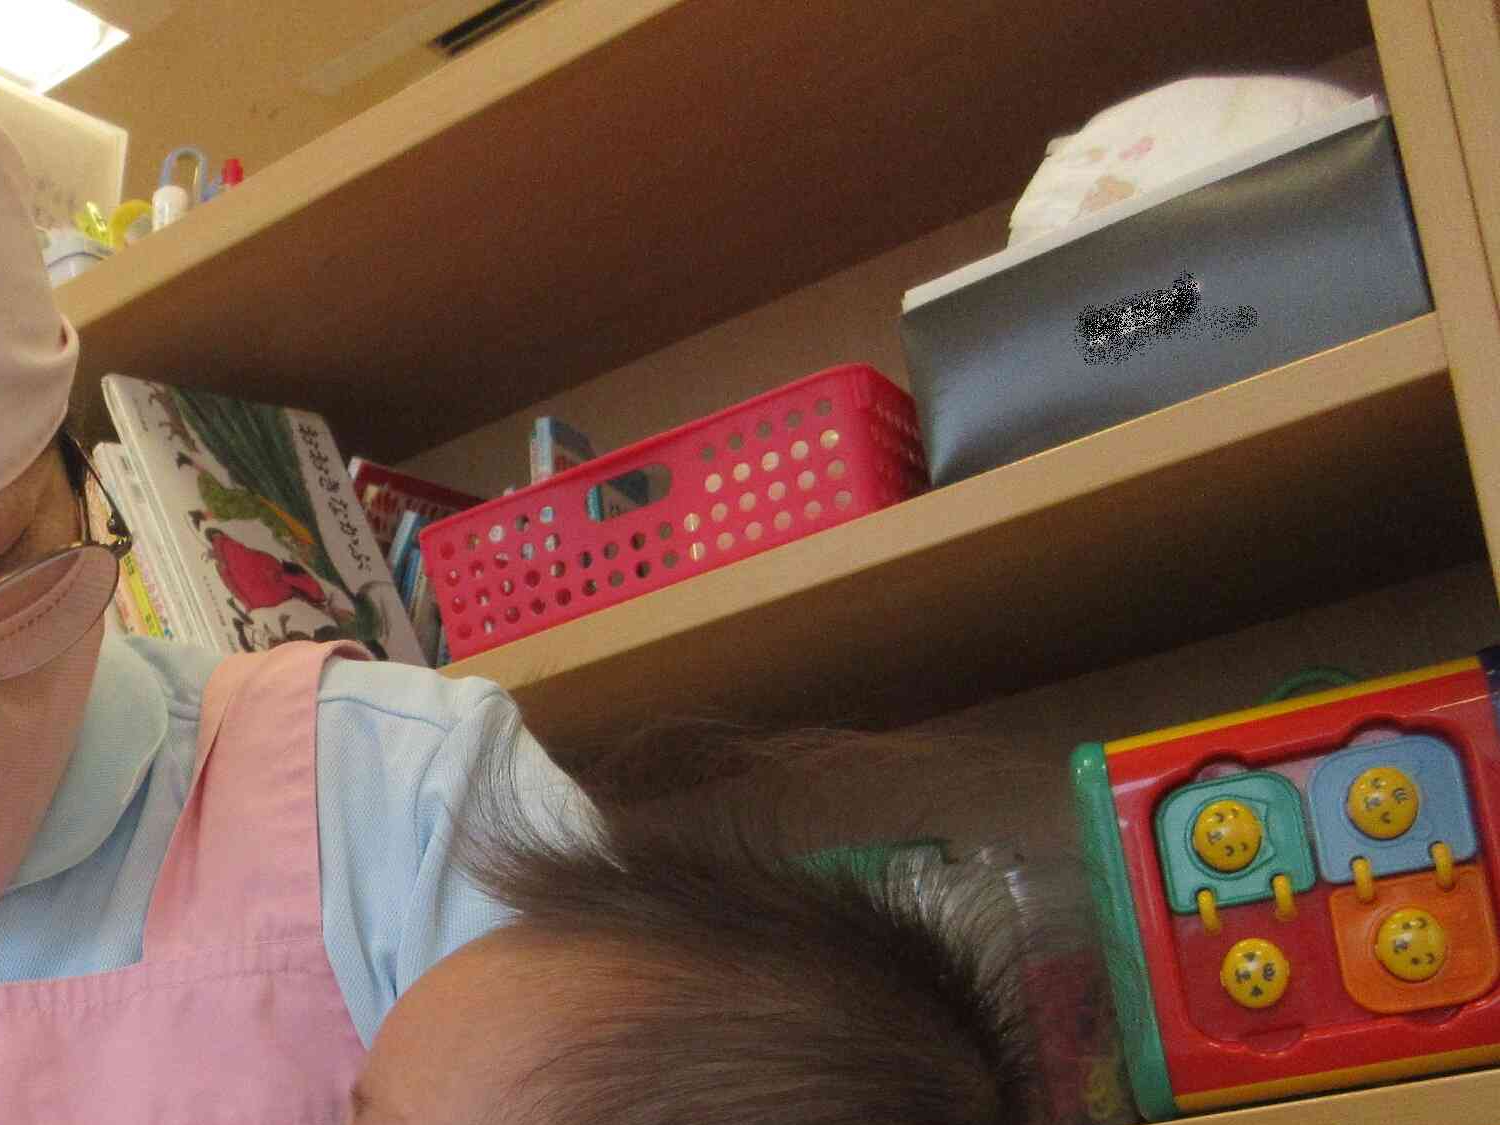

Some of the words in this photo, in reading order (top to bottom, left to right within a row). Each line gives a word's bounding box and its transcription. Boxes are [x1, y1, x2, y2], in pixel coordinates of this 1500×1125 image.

[298, 423, 372, 573] おおきなかぶ
